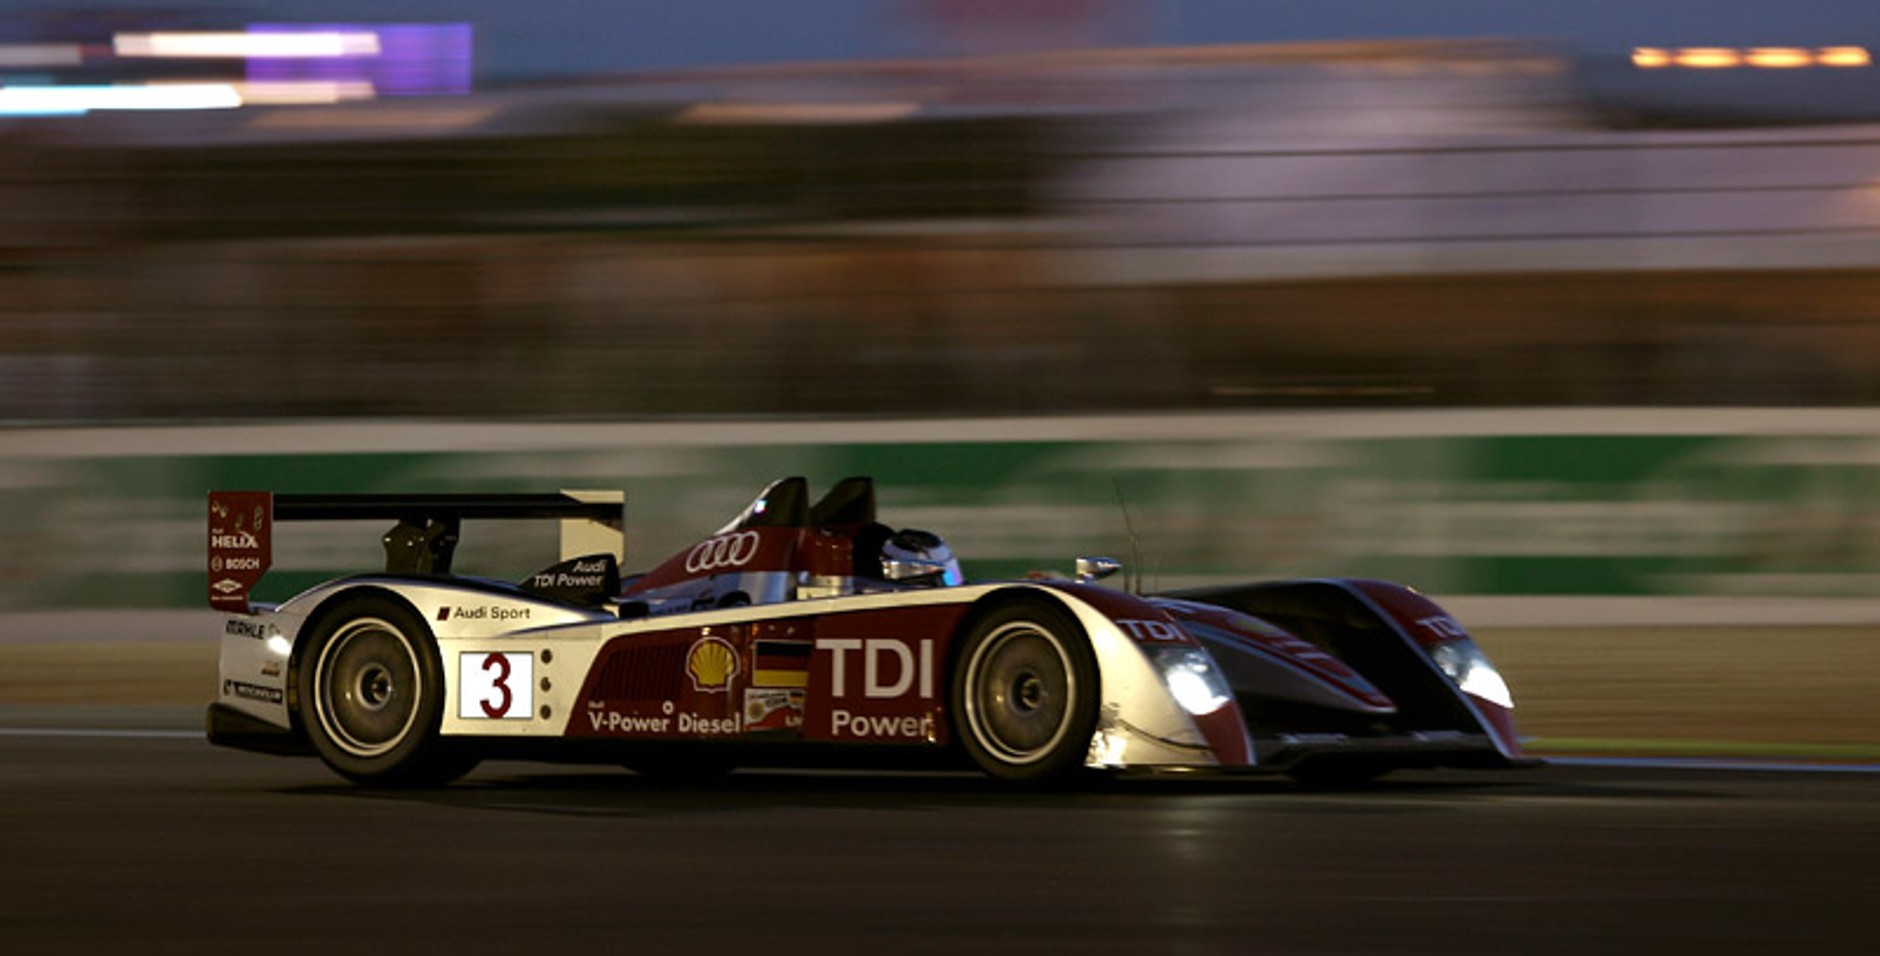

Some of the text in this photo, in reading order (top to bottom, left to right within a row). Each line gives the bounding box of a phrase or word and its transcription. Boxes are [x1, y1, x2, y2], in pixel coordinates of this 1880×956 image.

[211, 533, 259, 548] HELIX
[226, 558, 260, 570] BOSCH
[573, 561, 606, 572] Audi
[534, 574, 602, 587] TDI Power
[454, 607, 531, 621] Audi Sport
[1116, 619, 1187, 641] TDI
[815, 638, 933, 698] TDI
[479, 652, 512, 719] 3
[588, 711, 741, 733] V-Power Diesel
[831, 709, 930, 737] Power
